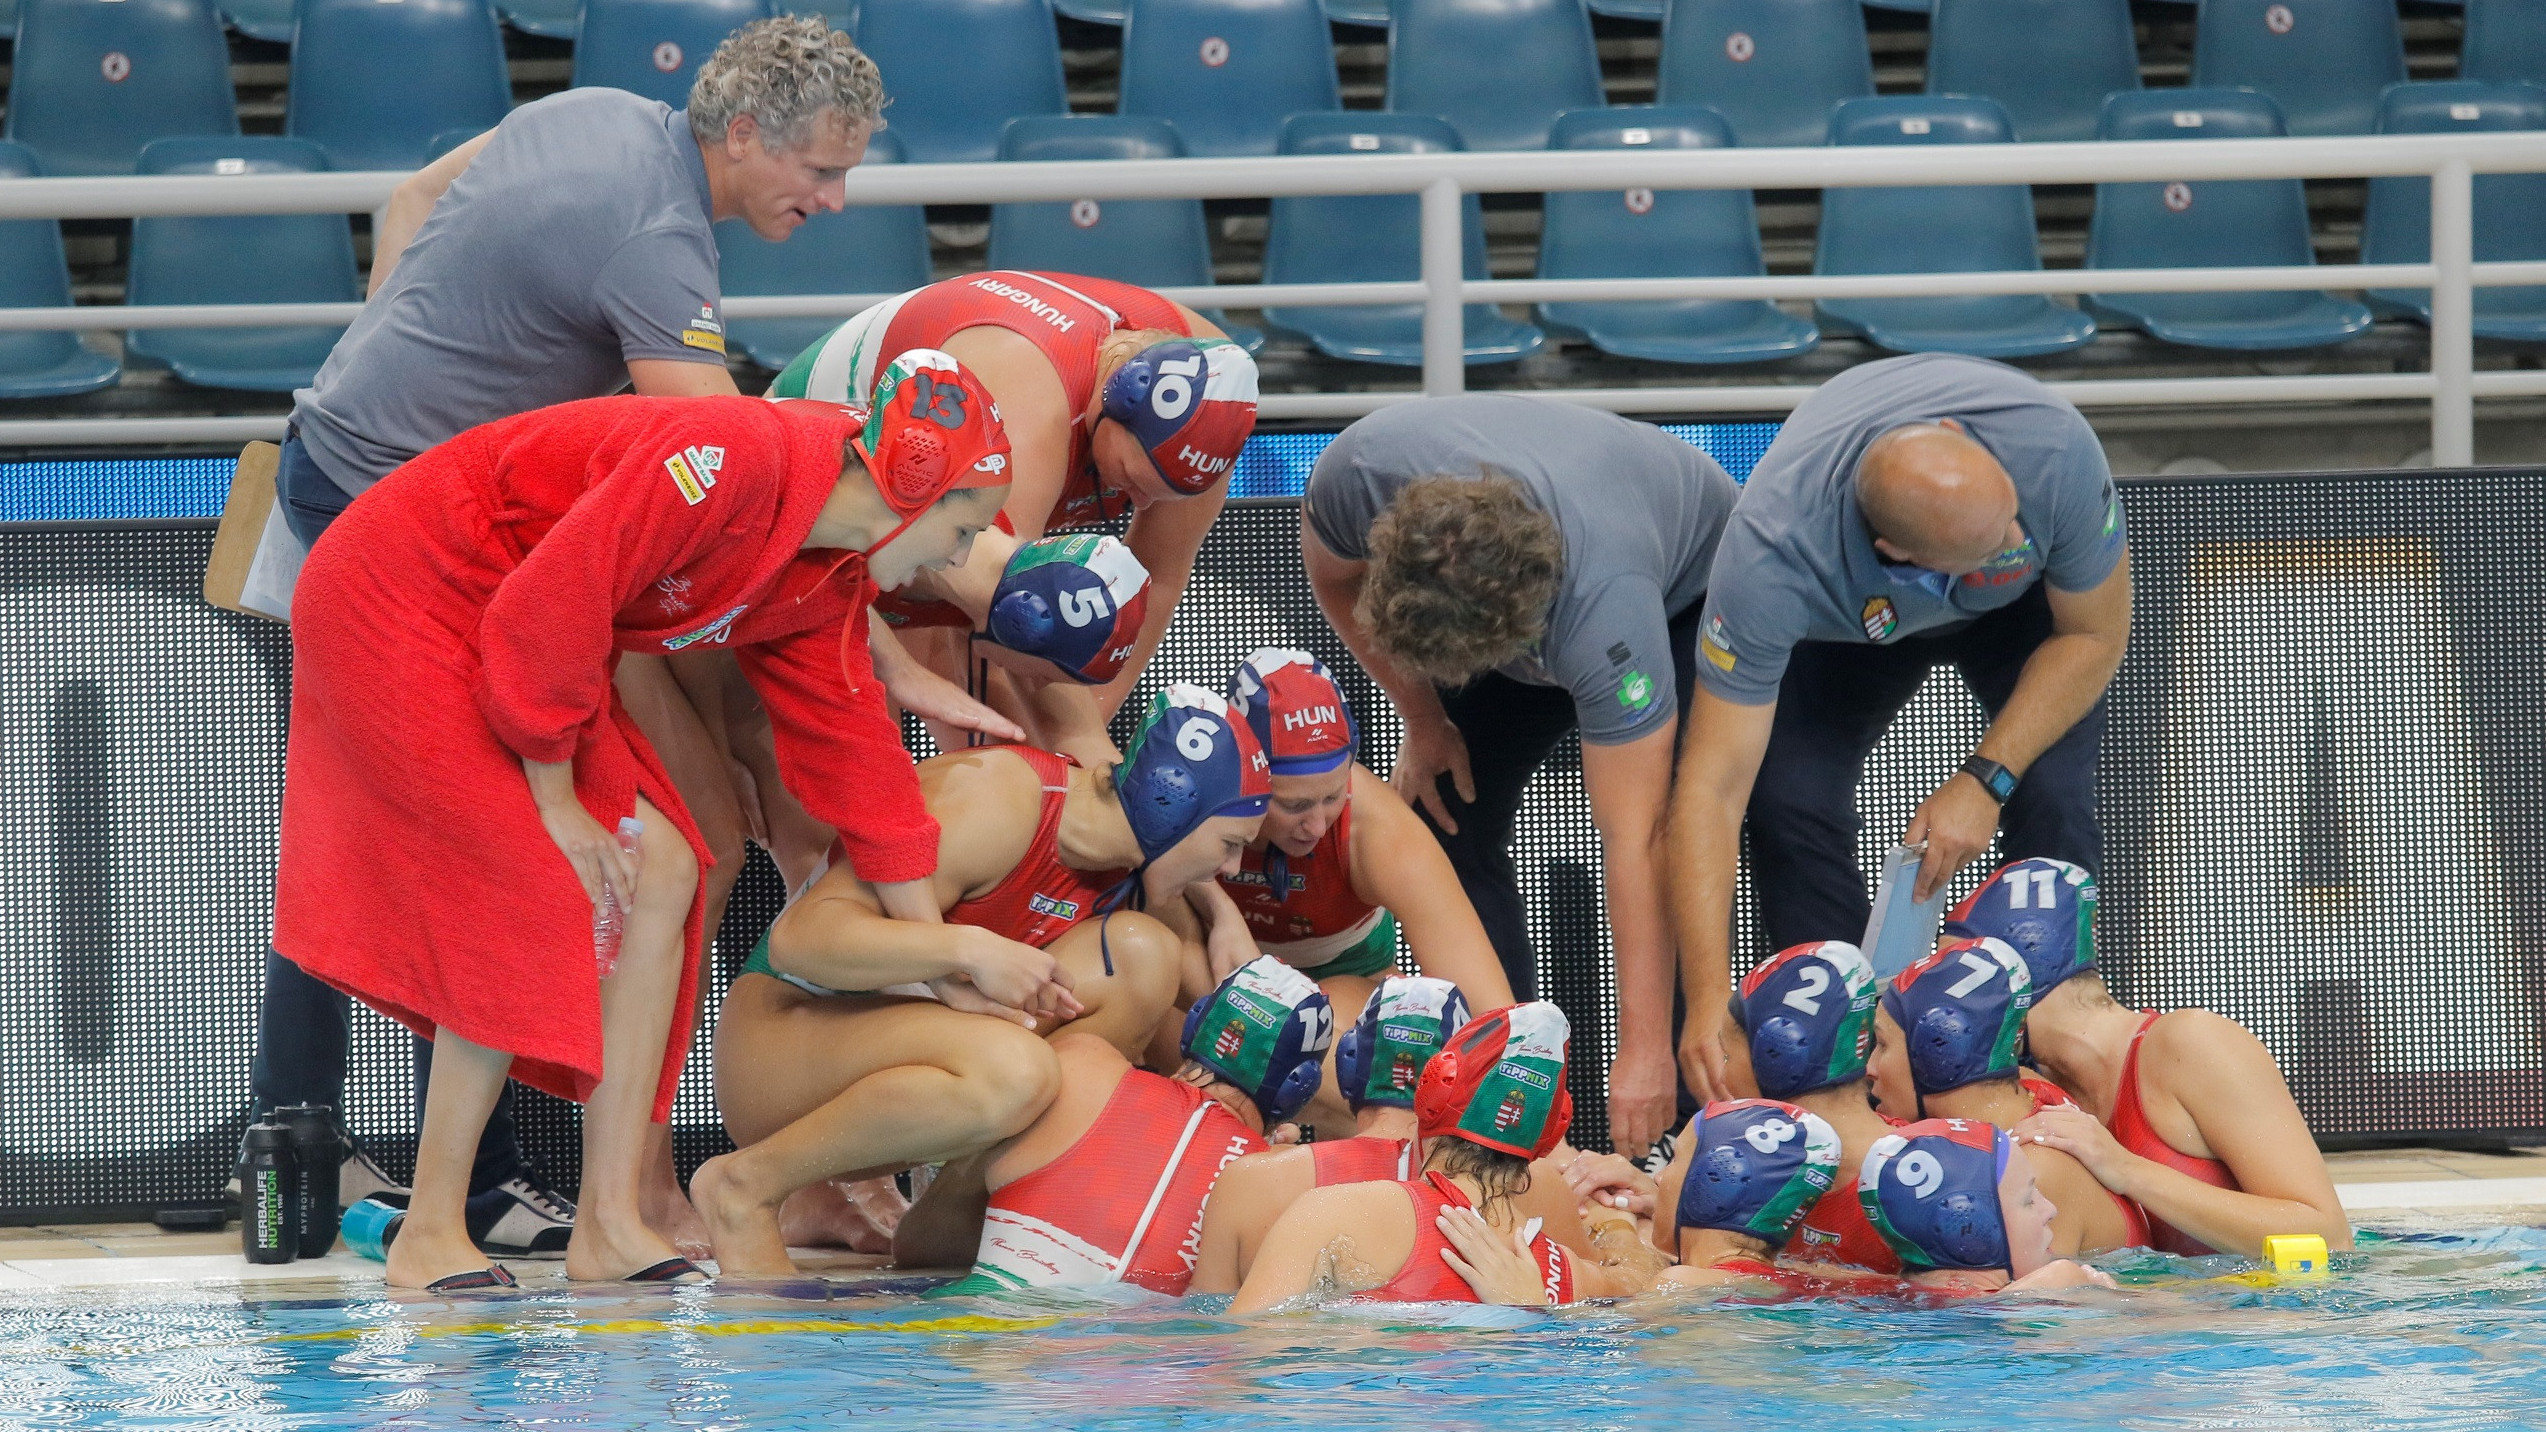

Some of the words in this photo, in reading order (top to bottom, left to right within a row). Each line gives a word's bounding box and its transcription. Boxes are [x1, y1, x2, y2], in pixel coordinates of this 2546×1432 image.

[968, 278, 1076, 333] HUNGARY
[910, 374, 967, 430] 13
[1152, 355, 1201, 420] 10
[1178, 444, 1231, 474] HUN
[1058, 586, 1110, 628] 5
[1175, 716, 1221, 762] 6
[1283, 705, 1337, 732] HUN
[2003, 868, 2058, 910] 11
[1782, 965, 1831, 1016] 2
[1944, 952, 1999, 999] 7
[1298, 1004, 1334, 1053] 12
[1745, 1118, 1797, 1154] 8
[1896, 1150, 1944, 1200] 9
[258, 1170, 268, 1248] HERBALIFE
[267, 1170, 278, 1248] NUTRITION
[300, 1171, 308, 1235] MYPROTEIN
